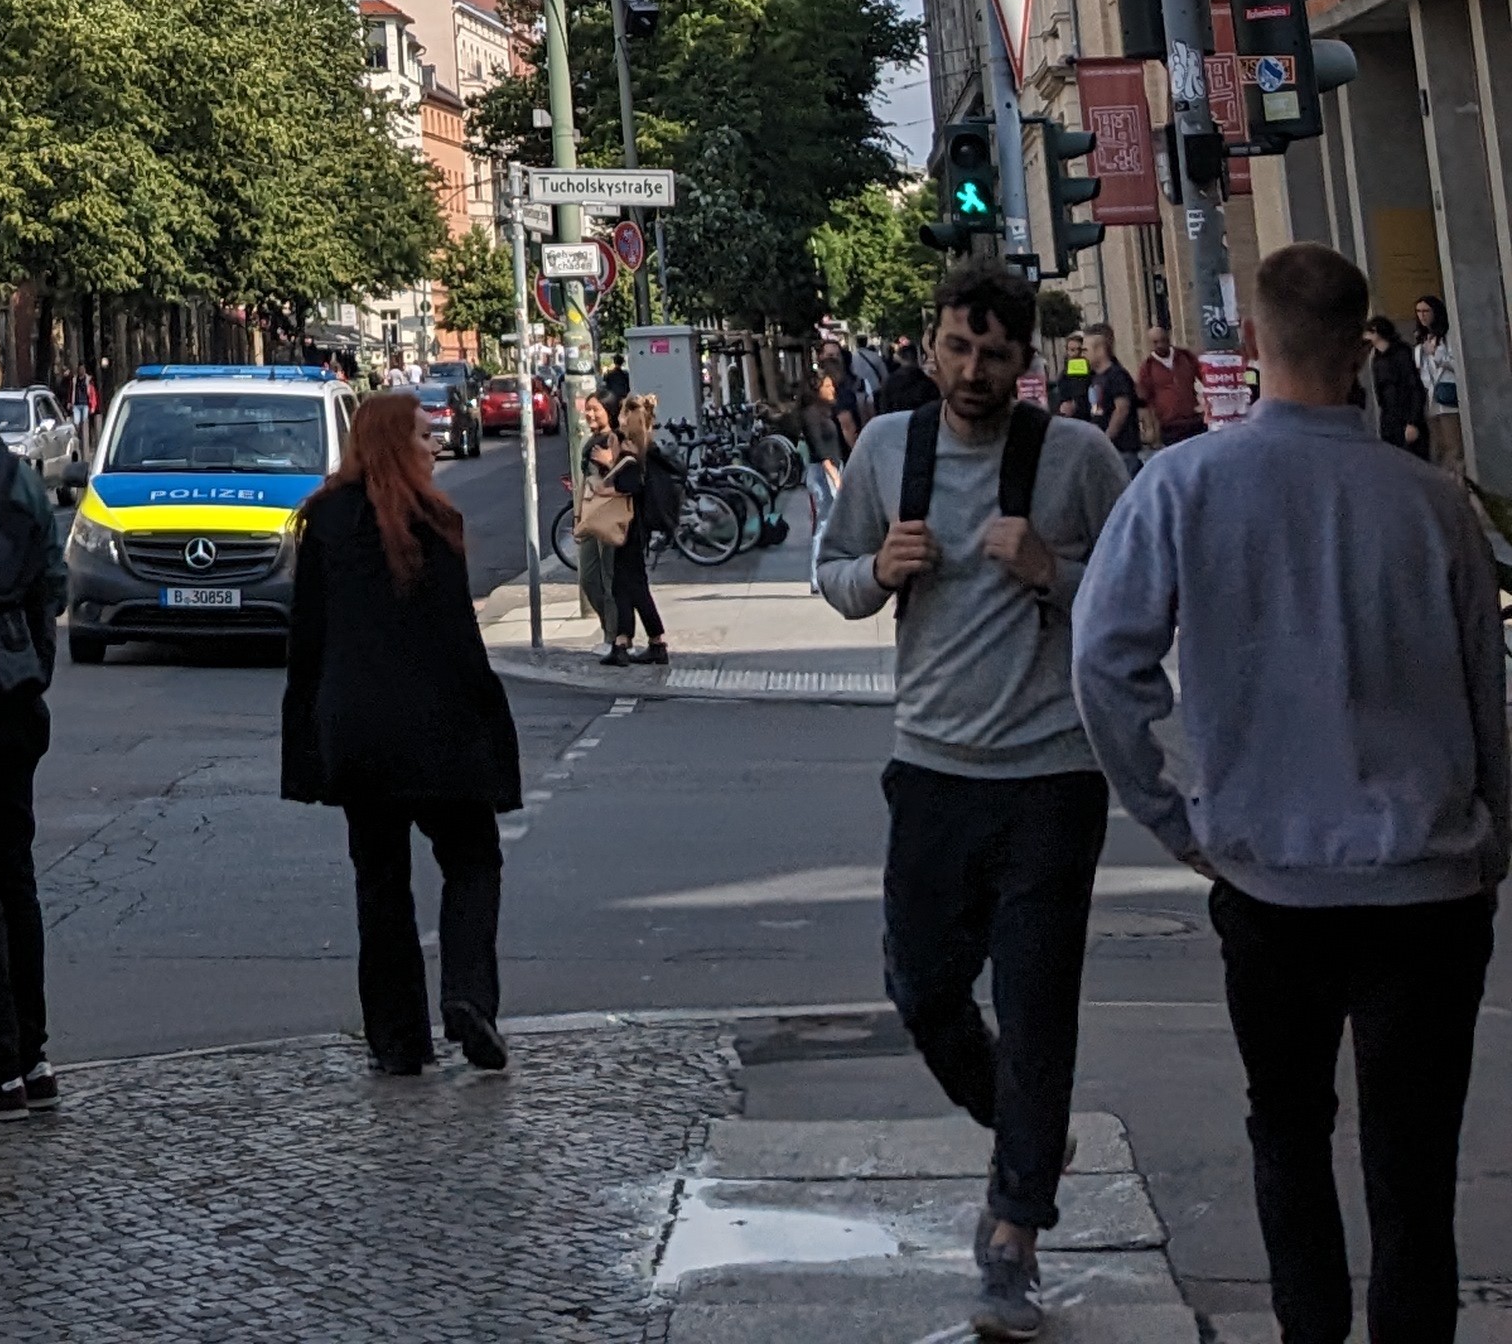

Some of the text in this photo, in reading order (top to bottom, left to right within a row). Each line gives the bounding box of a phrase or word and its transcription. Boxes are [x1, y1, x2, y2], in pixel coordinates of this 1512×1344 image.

[538, 177, 663, 198] Tucholskystraße
[150, 488, 264, 501] POLIZEI
[174, 589, 233, 605] B 30858
